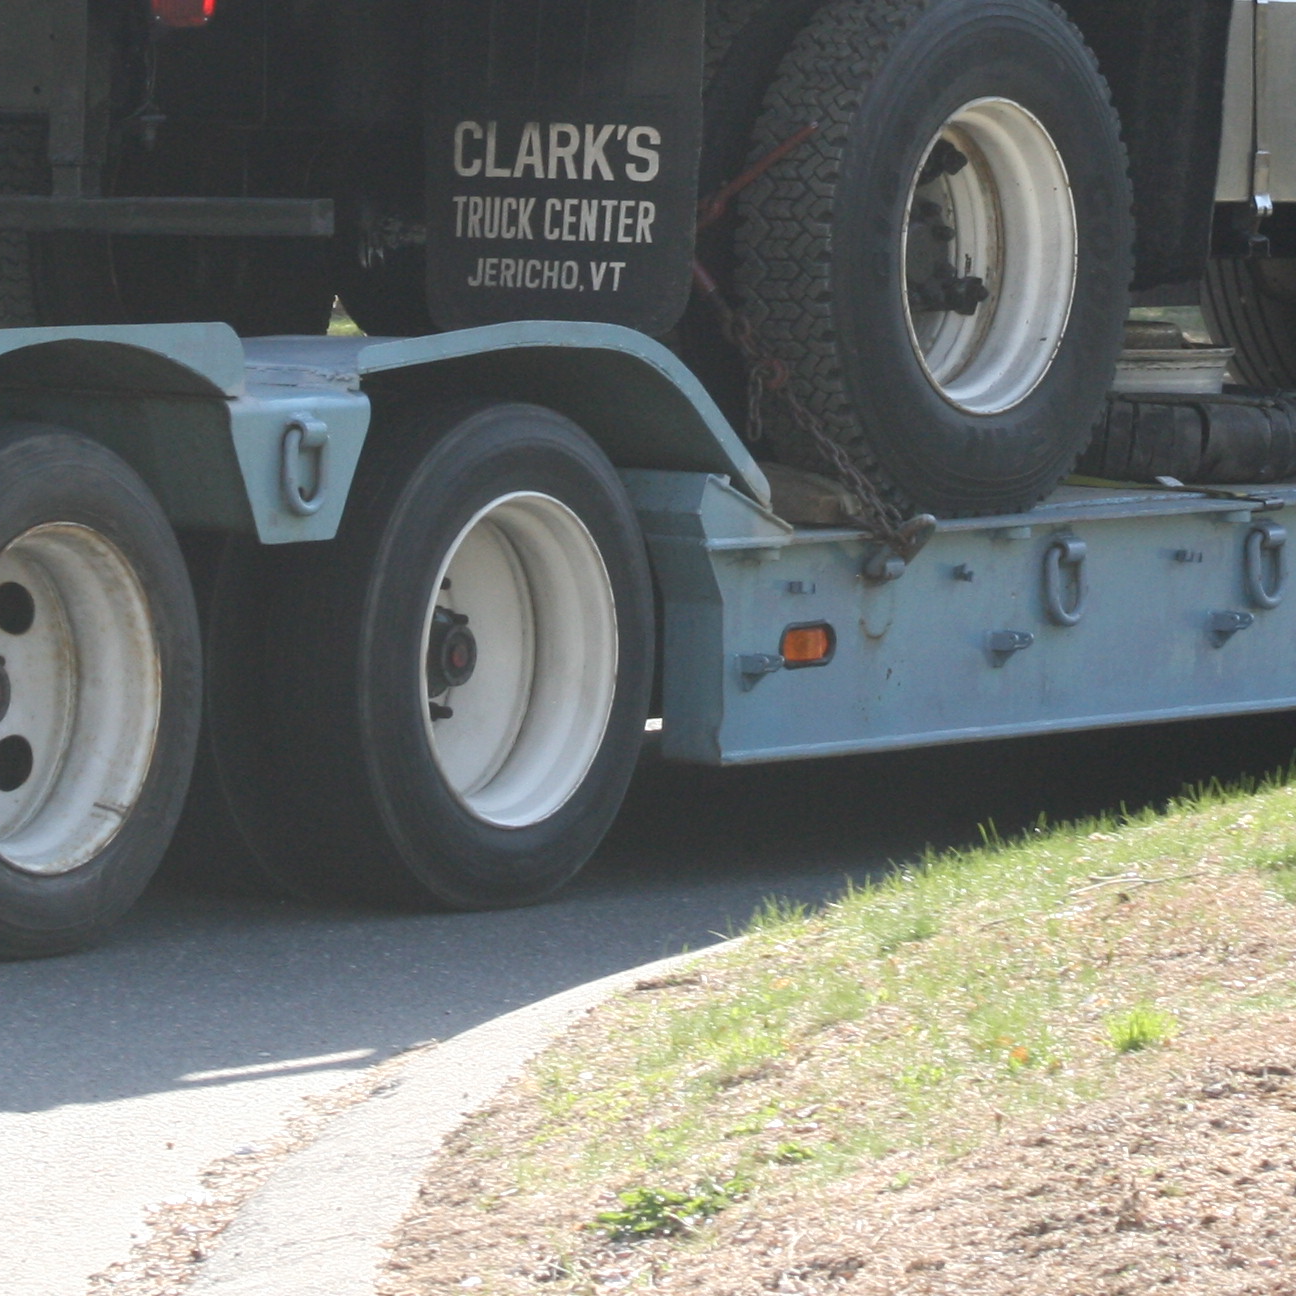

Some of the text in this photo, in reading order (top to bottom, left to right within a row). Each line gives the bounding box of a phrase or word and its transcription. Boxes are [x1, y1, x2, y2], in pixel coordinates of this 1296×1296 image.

[454, 120, 662, 182] CLARK'S
[453, 195, 656, 244] TRUCK CENTER
